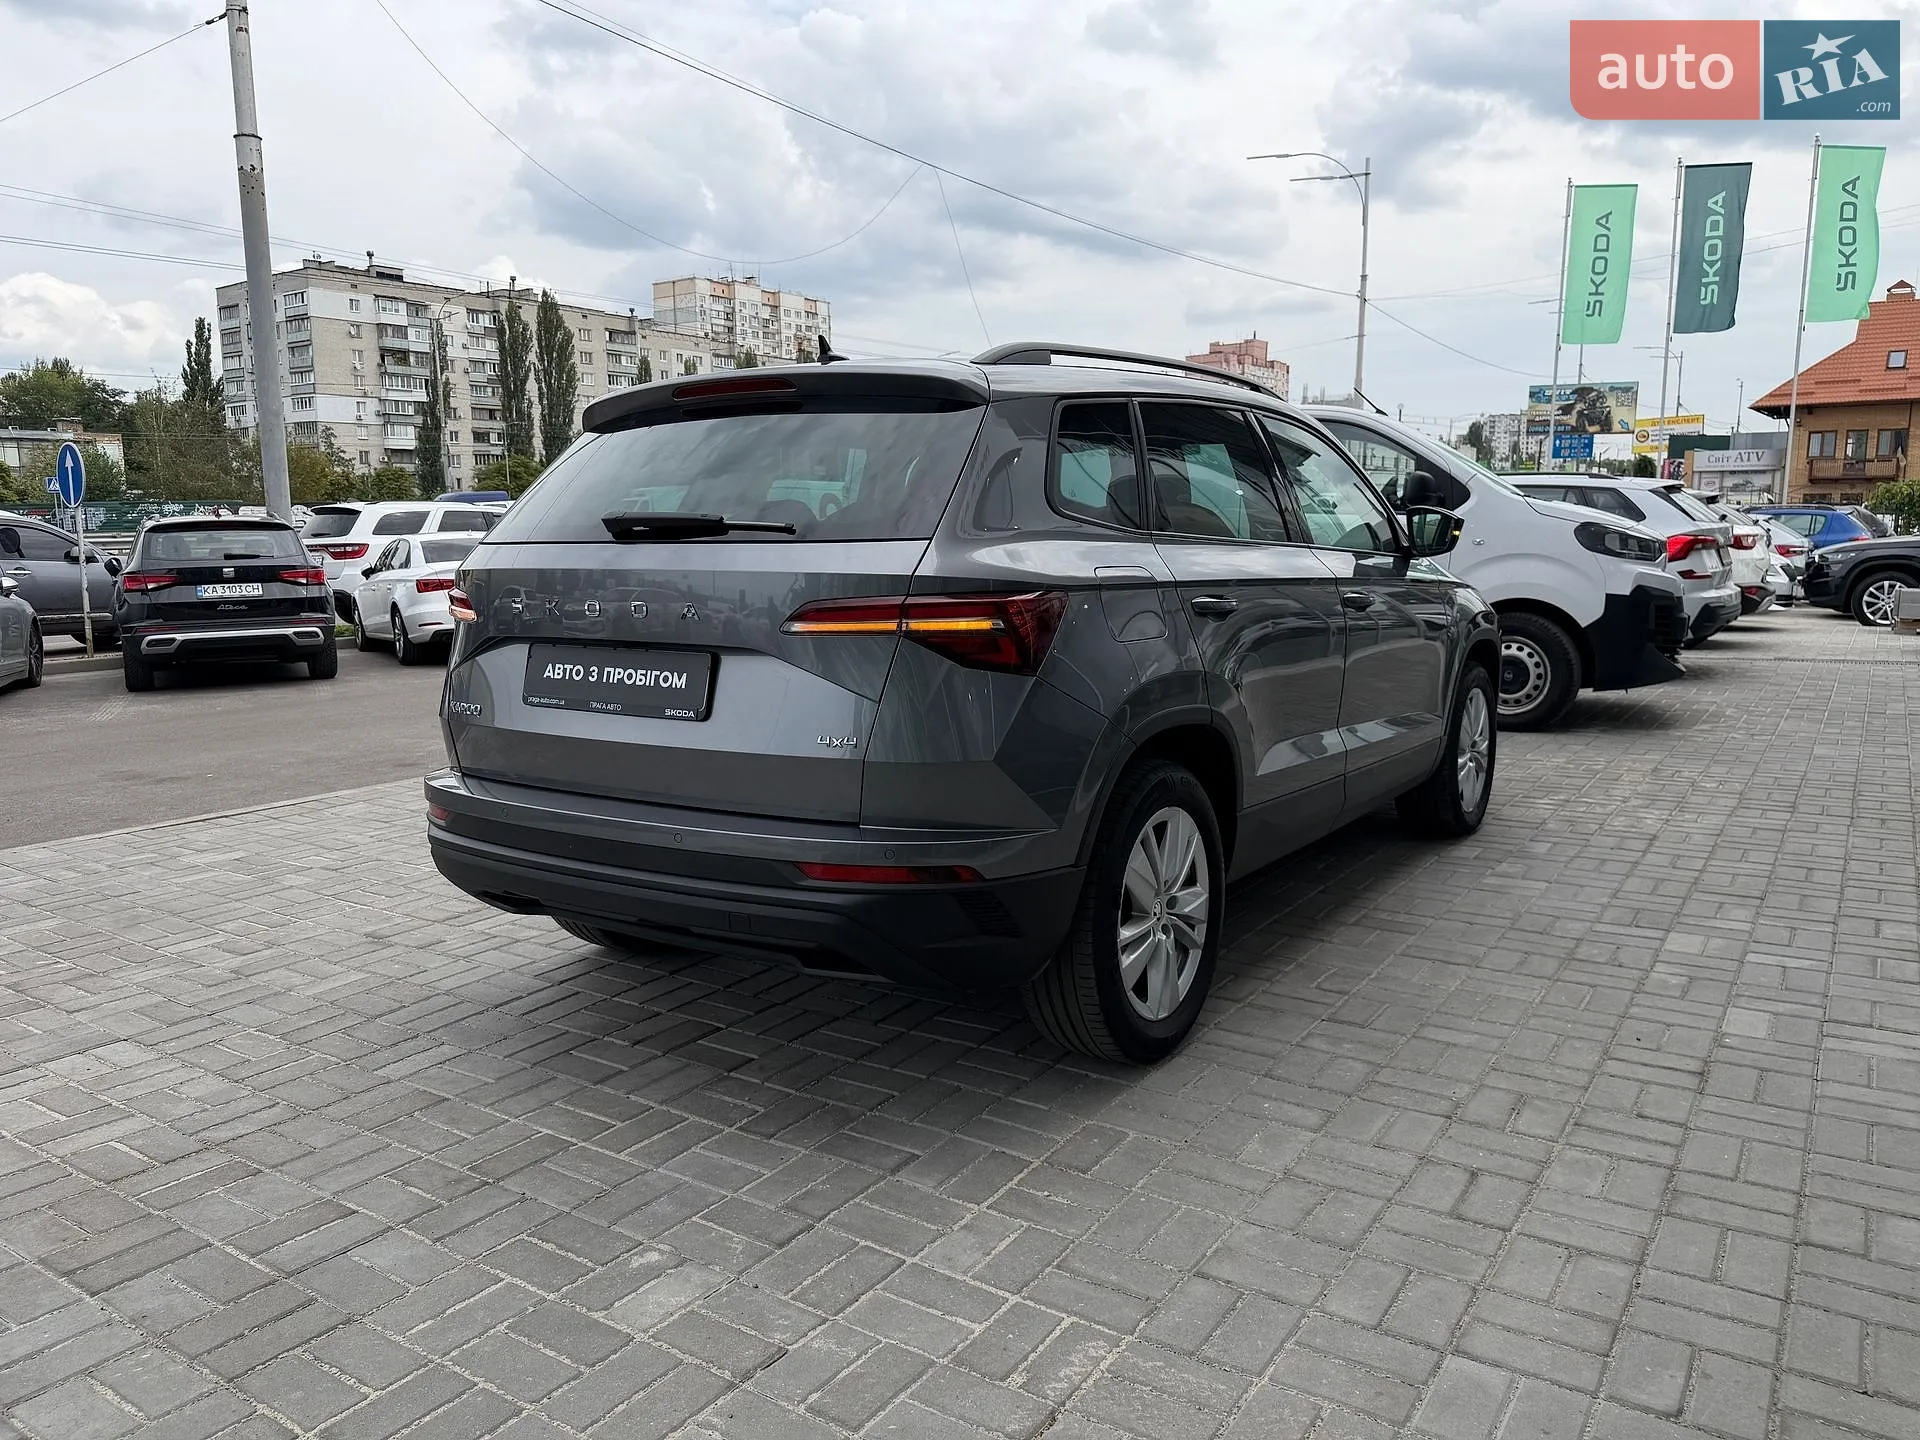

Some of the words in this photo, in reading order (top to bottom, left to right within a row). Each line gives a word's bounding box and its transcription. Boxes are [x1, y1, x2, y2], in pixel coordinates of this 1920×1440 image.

[1734, 450, 1766, 463] ATV
[220, 584, 243, 594] 3103
[543, 662, 584, 681] АВТО
[602, 667, 687, 689] ПРОБІГОМ
[450, 701, 481, 718] KAROQ
[589, 701, 606, 710] ПРАГА
[606, 703, 622, 711] АВТО
